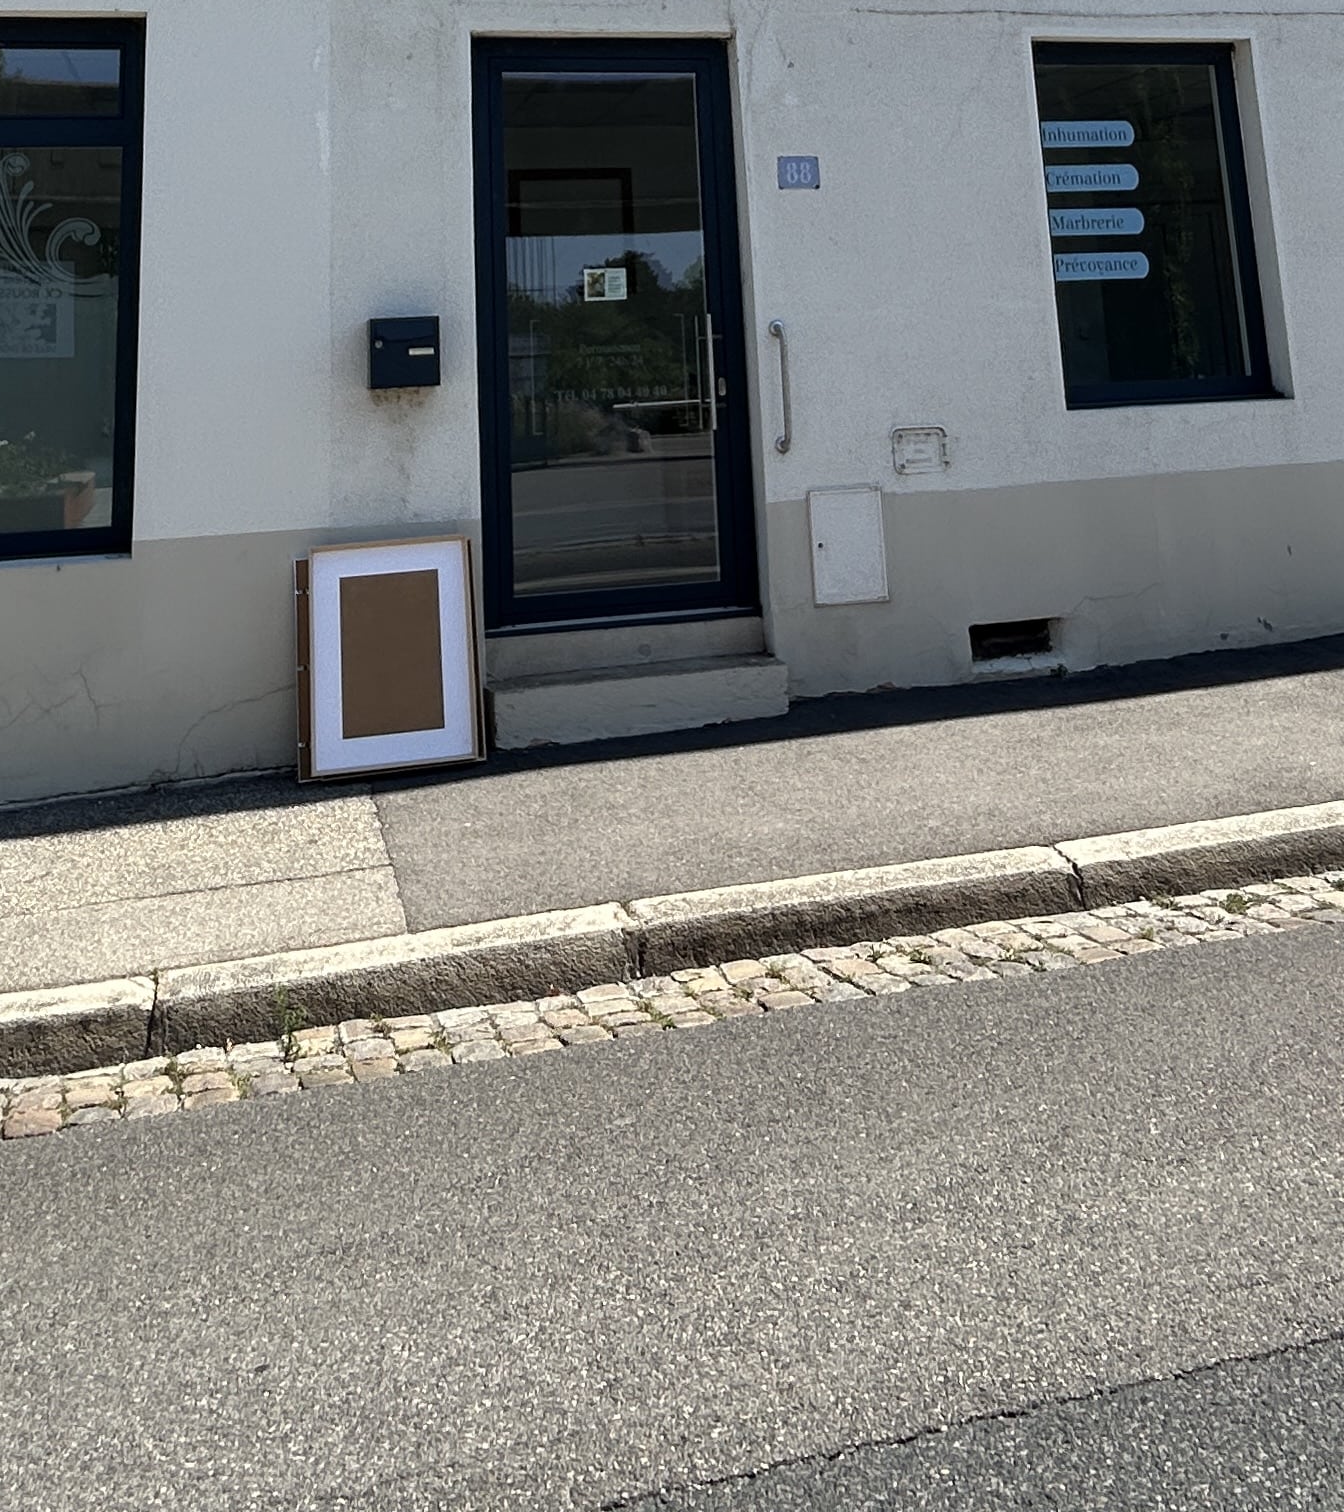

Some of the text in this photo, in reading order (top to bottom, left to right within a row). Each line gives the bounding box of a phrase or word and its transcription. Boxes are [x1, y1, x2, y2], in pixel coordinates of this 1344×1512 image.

[1042, 128, 1128, 142] Inhumation
[786, 161, 812, 184] 88
[1046, 170, 1122, 186] Crémation
[1051, 215, 1125, 231] Marbrerie
[1056, 256, 1139, 276] Prévoyance
